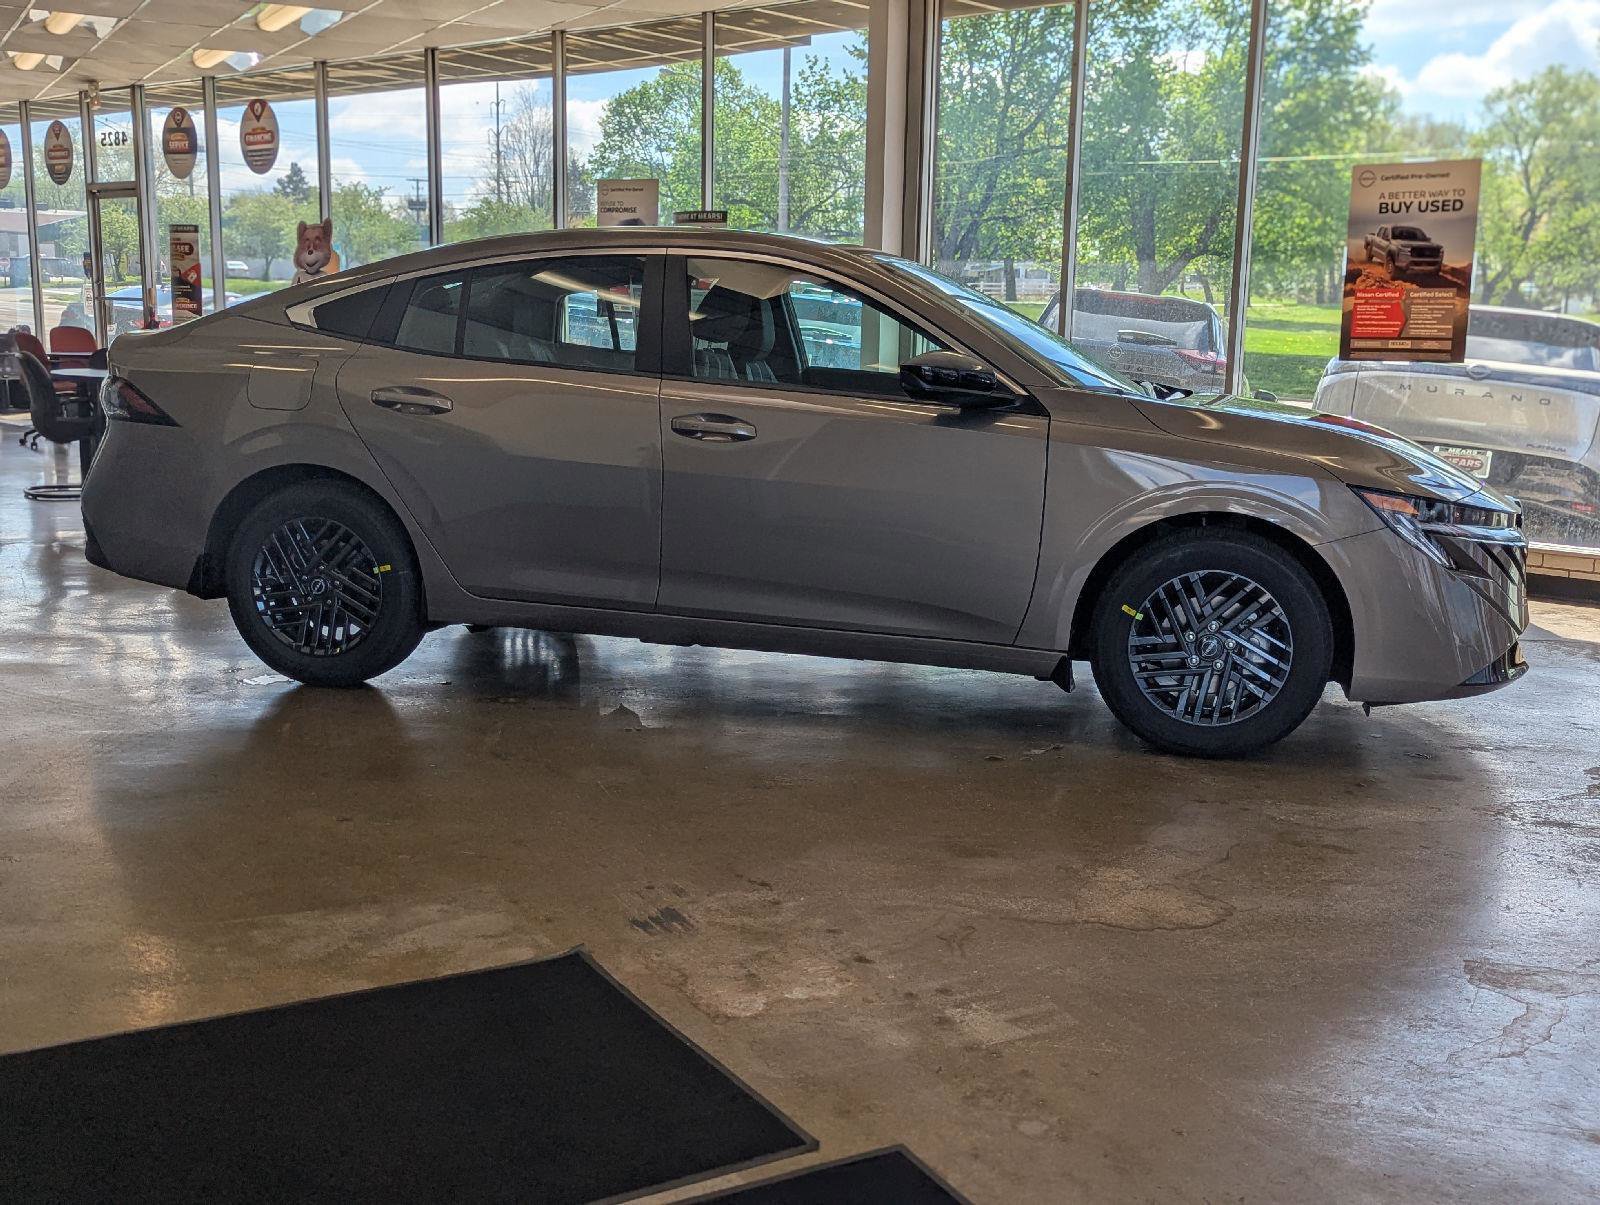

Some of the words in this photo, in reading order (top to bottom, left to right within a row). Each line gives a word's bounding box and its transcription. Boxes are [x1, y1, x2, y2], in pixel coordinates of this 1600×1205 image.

[1411, 171, 1450, 179] Pre-Owned
[1379, 192, 1386, 200] A
[1388, 190, 1426, 200] BETTER
[1428, 189, 1449, 198] WAY
[1452, 188, 1466, 197] TO
[1379, 201, 1414, 214] BUY
[1418, 199, 1464, 213] USED
[1399, 383, 1551, 406] MURANO
[1447, 446, 1479, 456] MEARS
